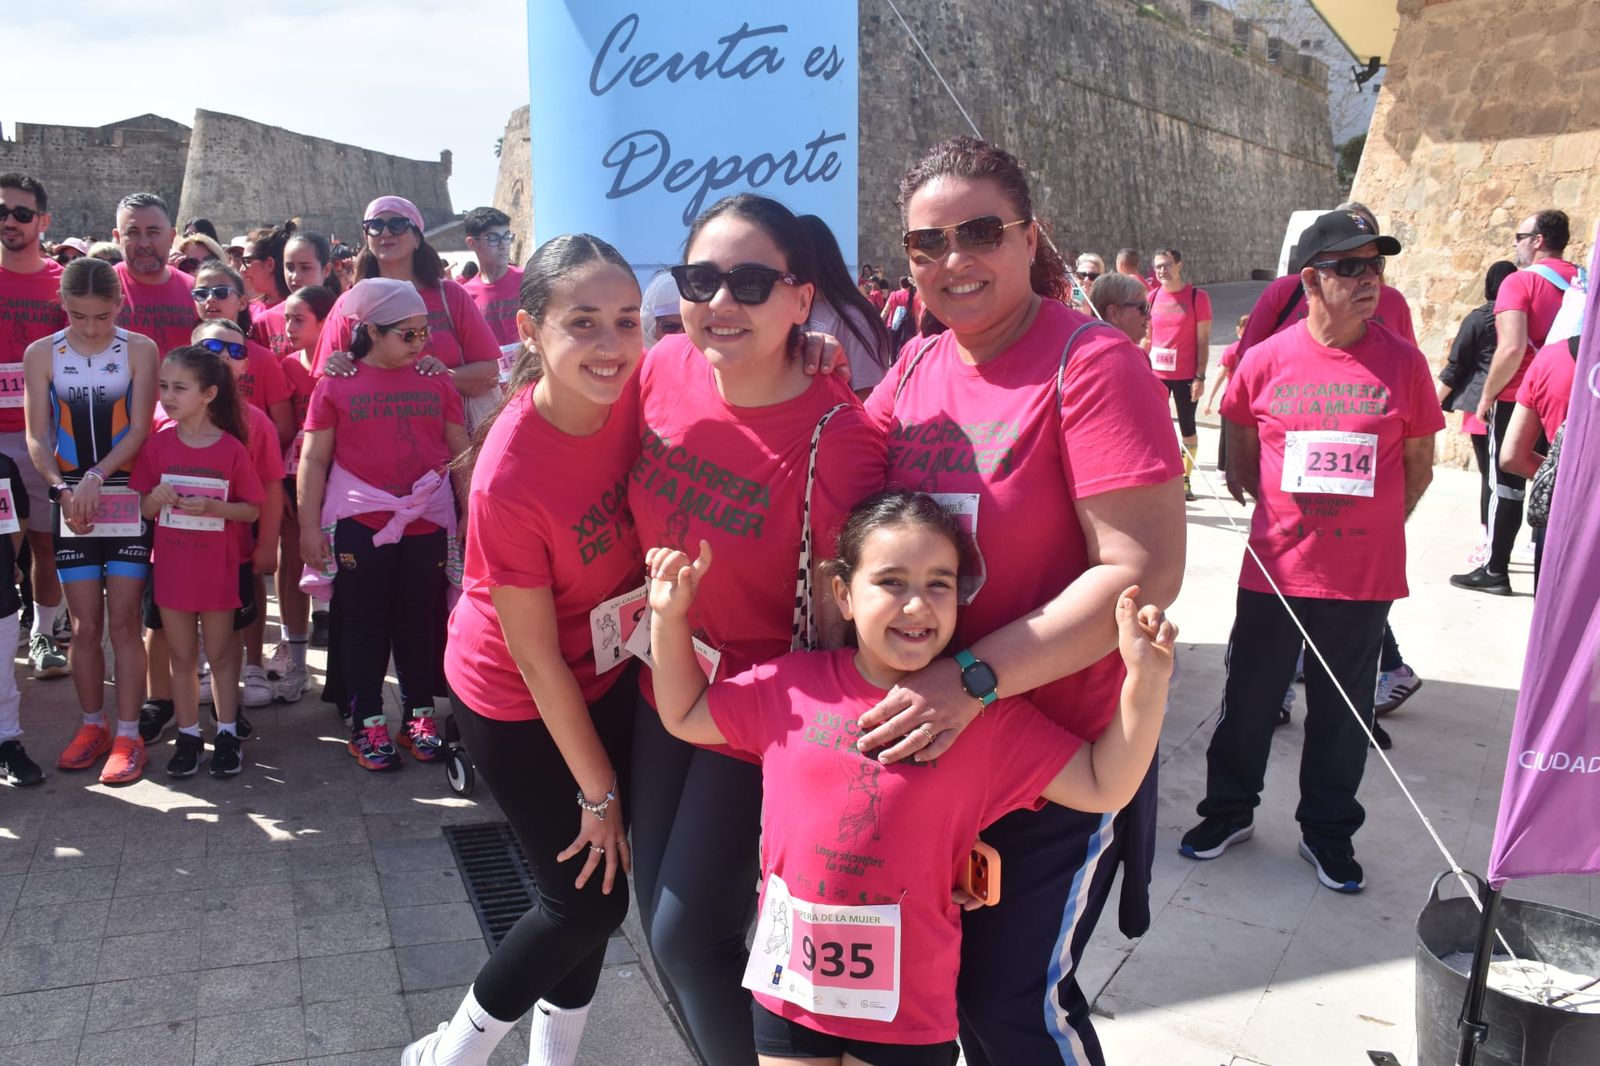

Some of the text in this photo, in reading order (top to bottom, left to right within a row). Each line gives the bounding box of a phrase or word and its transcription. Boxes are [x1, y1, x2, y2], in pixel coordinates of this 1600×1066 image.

[589, 13, 845, 96] Ceuta es
[602, 129, 846, 227] Deporte
[374, 391, 440, 404] CARRERA
[1274, 383, 1390, 400] XXI CARRERA
[350, 406, 370, 422] DE
[1270, 400, 1388, 416] DE LA MUJER
[1307, 451, 1371, 475] 2314
[666, 446, 771, 511] CARRERA
[97, 501, 136, 519] 529
[679, 486, 766, 539] MUJER
[579, 529, 614, 566] DE
[803, 726, 832, 748] DE
[821, 914, 833, 922] DE
[835, 914, 847, 922] LA
[849, 914, 881, 924] MUJER
[802, 935, 875, 979] 935
